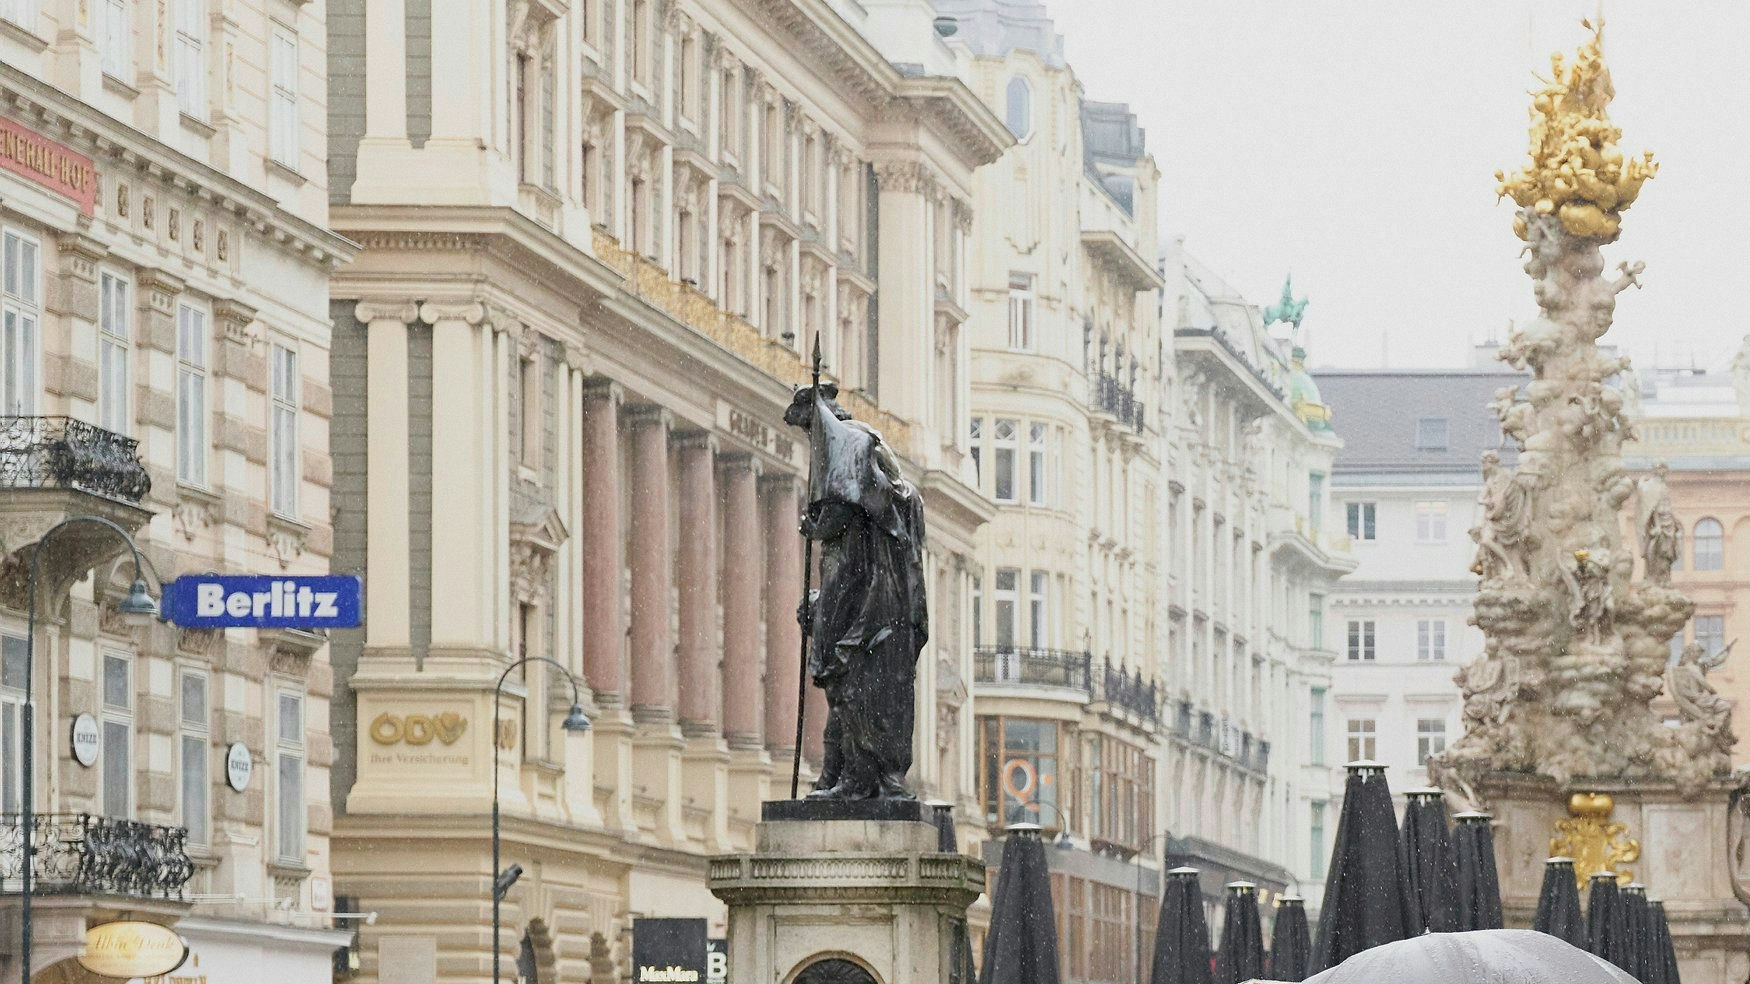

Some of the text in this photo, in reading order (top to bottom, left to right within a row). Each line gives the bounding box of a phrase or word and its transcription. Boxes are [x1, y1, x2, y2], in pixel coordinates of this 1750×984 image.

[197, 580, 338, 617] Berlitz
[397, 754, 469, 766] Versicherung
[640, 965, 699, 982] MaxMara
